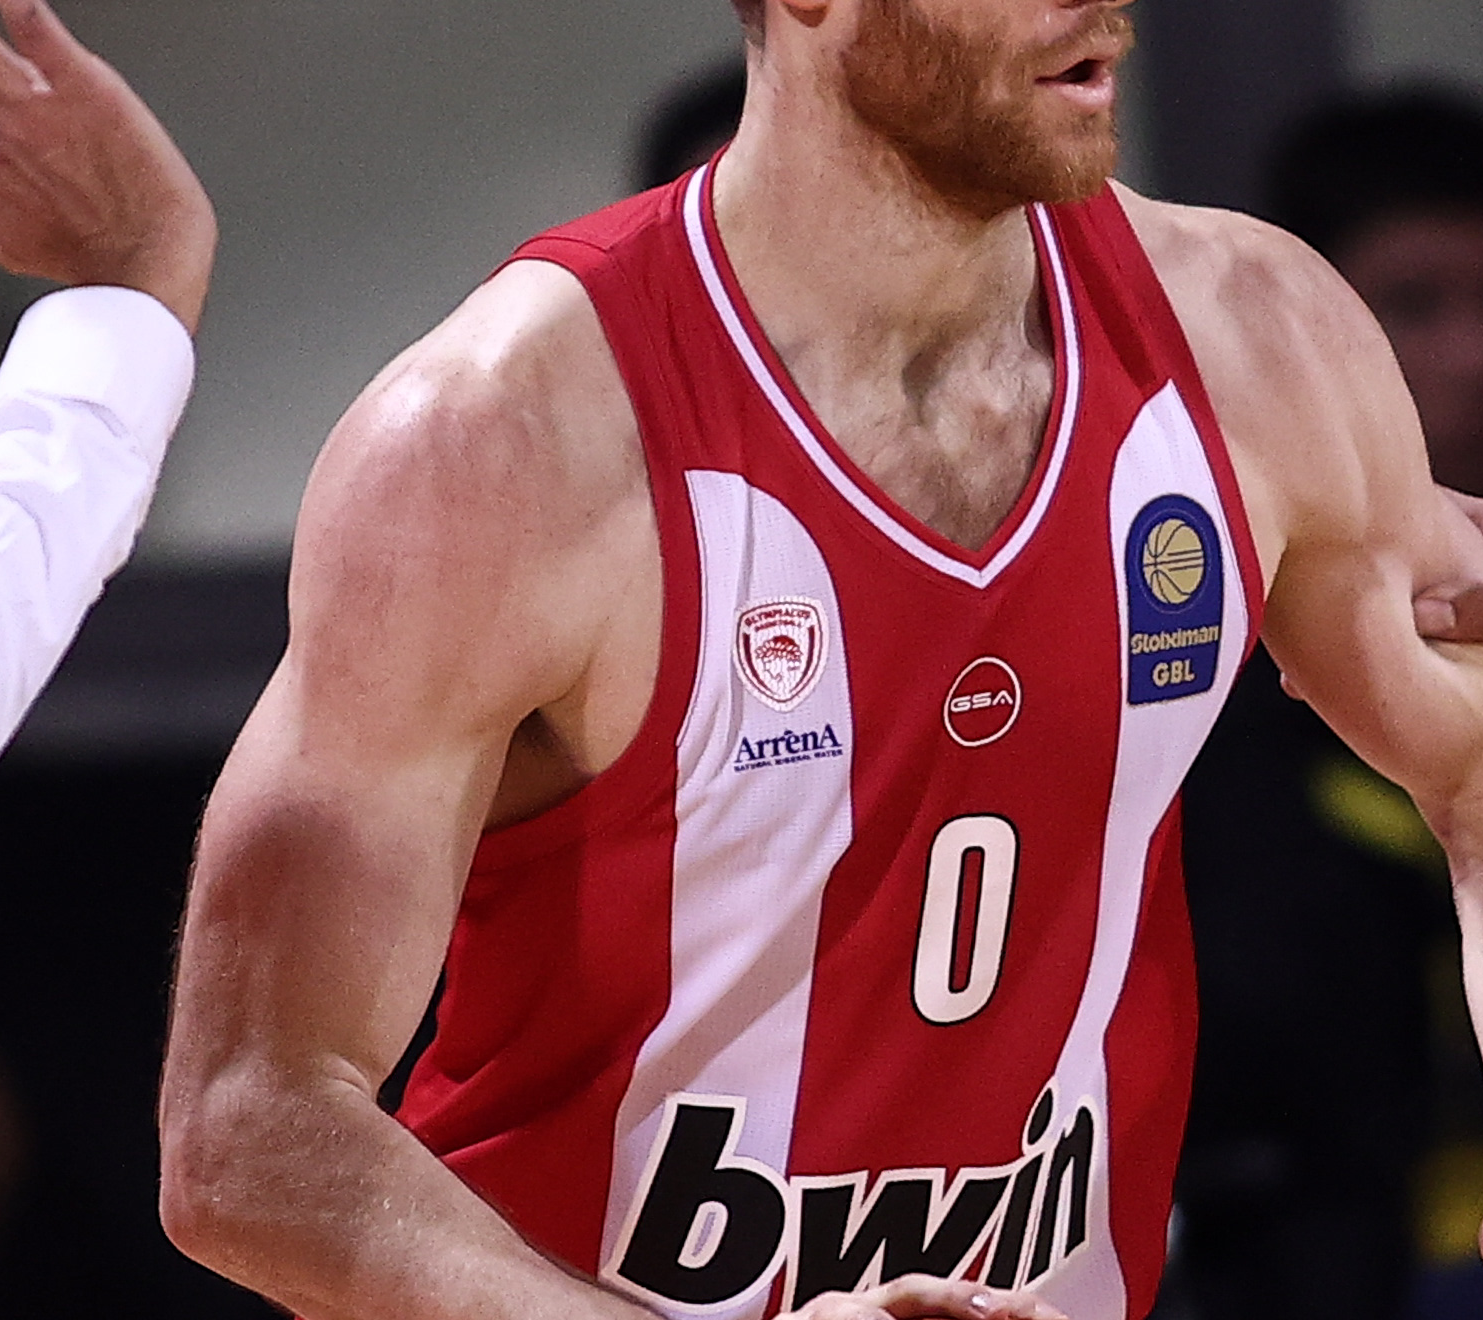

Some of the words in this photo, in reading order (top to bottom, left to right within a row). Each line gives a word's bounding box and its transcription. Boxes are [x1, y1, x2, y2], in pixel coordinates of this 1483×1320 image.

[949, 689, 1014, 713] GSA
[1151, 659, 1196, 687] GBL
[911, 813, 1018, 1026] 0
[616, 1083, 1098, 1313] bwin
